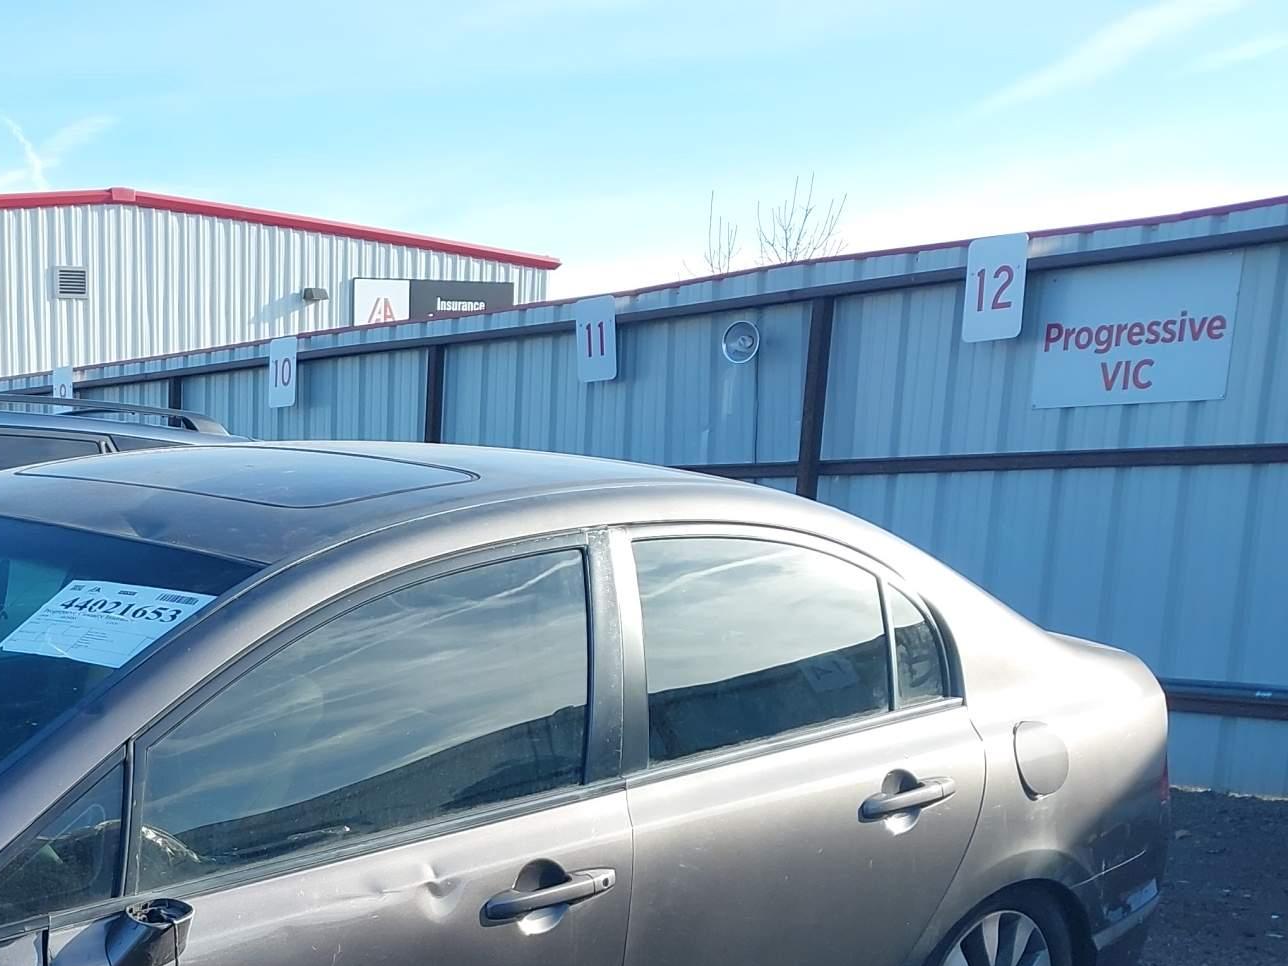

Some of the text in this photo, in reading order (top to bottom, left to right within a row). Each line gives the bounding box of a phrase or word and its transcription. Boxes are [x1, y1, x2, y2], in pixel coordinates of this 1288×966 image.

[436, 296, 486, 312] Insurance
[976, 264, 1014, 312] 12
[585, 321, 604, 358] 11
[1043, 310, 1227, 354] Progressive
[274, 357, 292, 388] 10
[1099, 358, 1155, 392] VIC
[61, 595, 183, 623] 44021653
